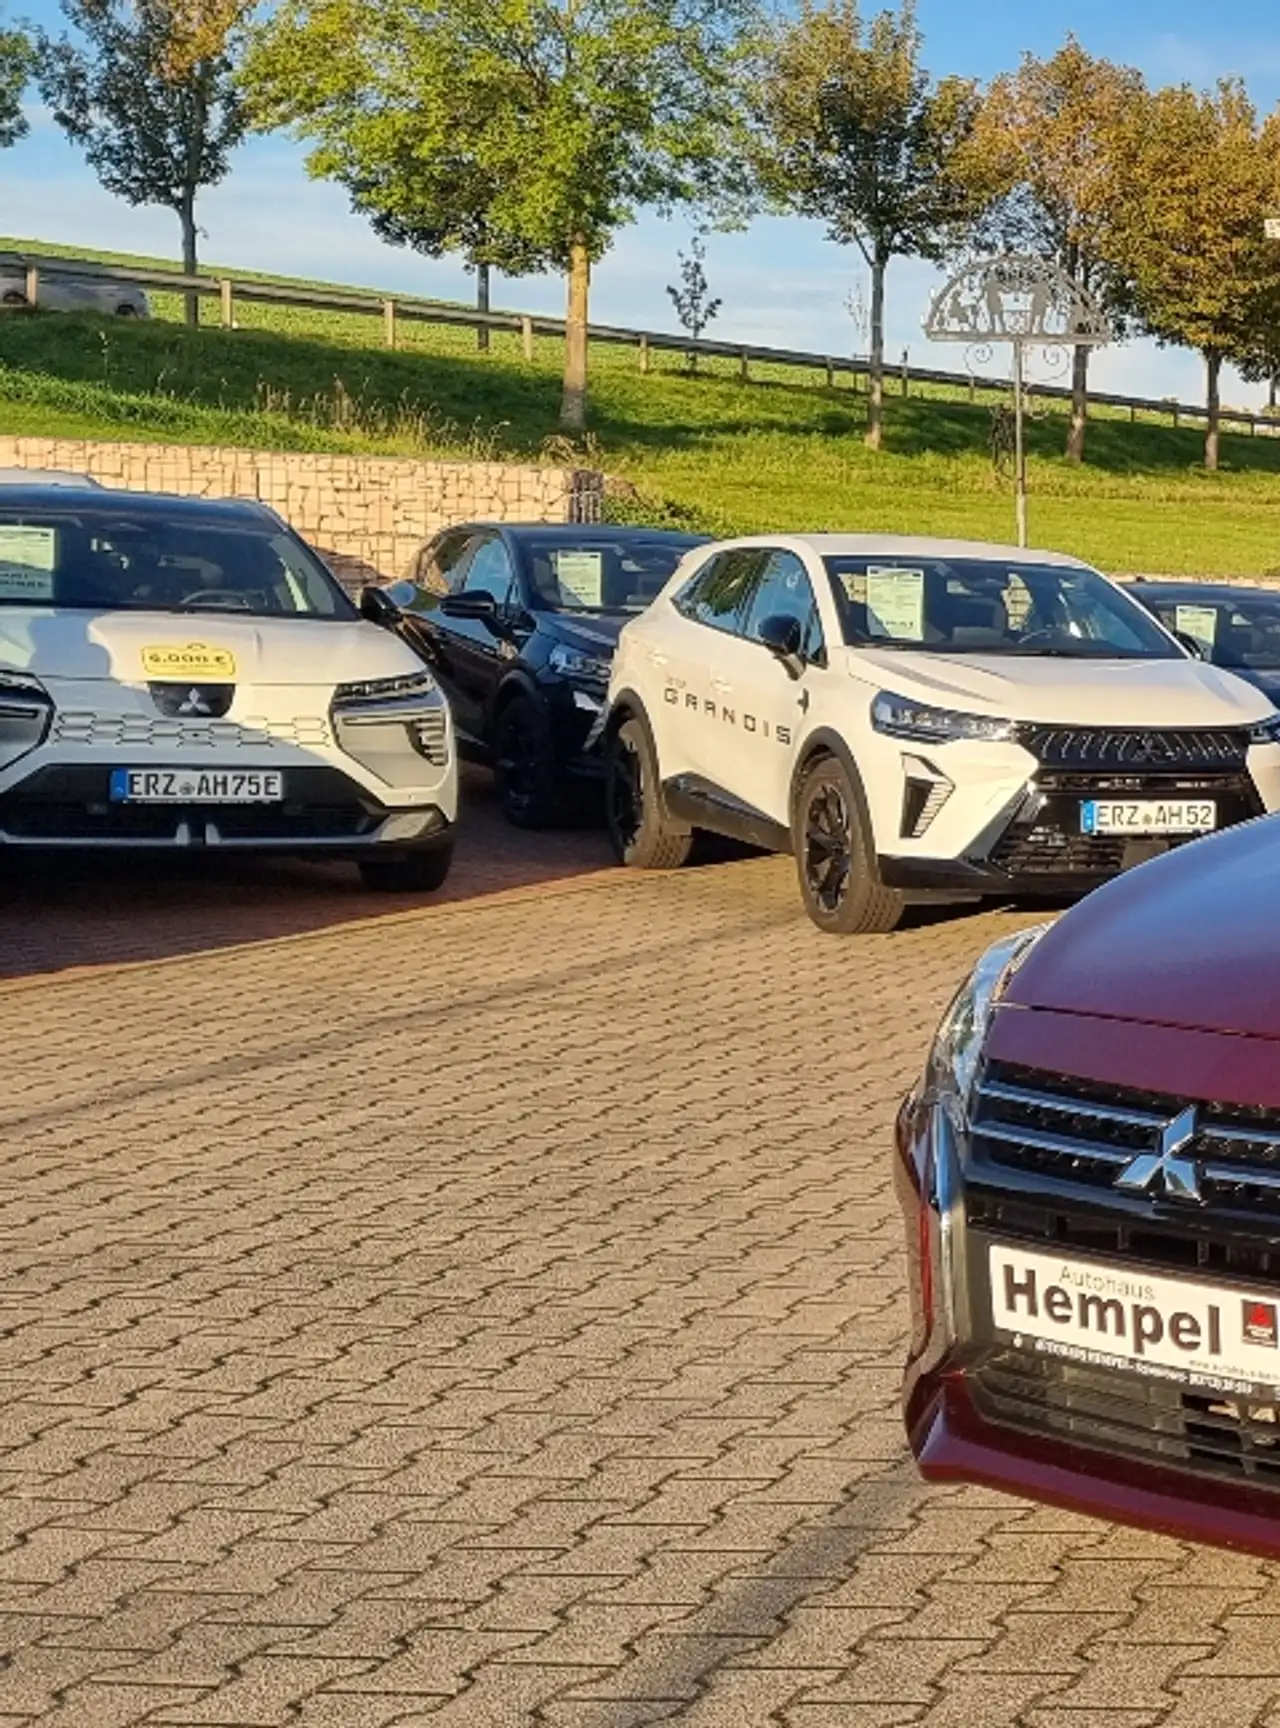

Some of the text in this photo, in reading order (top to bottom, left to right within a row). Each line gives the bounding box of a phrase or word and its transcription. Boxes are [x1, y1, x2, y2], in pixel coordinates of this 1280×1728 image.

[664, 688, 791, 745] GRANDIS
[129, 774, 280, 797] ERZ AH75E
[1097, 805, 1140, 826] ERZ
[1058, 1265, 1156, 1301] Autohaus
[1002, 1263, 1222, 1356] Hempel
